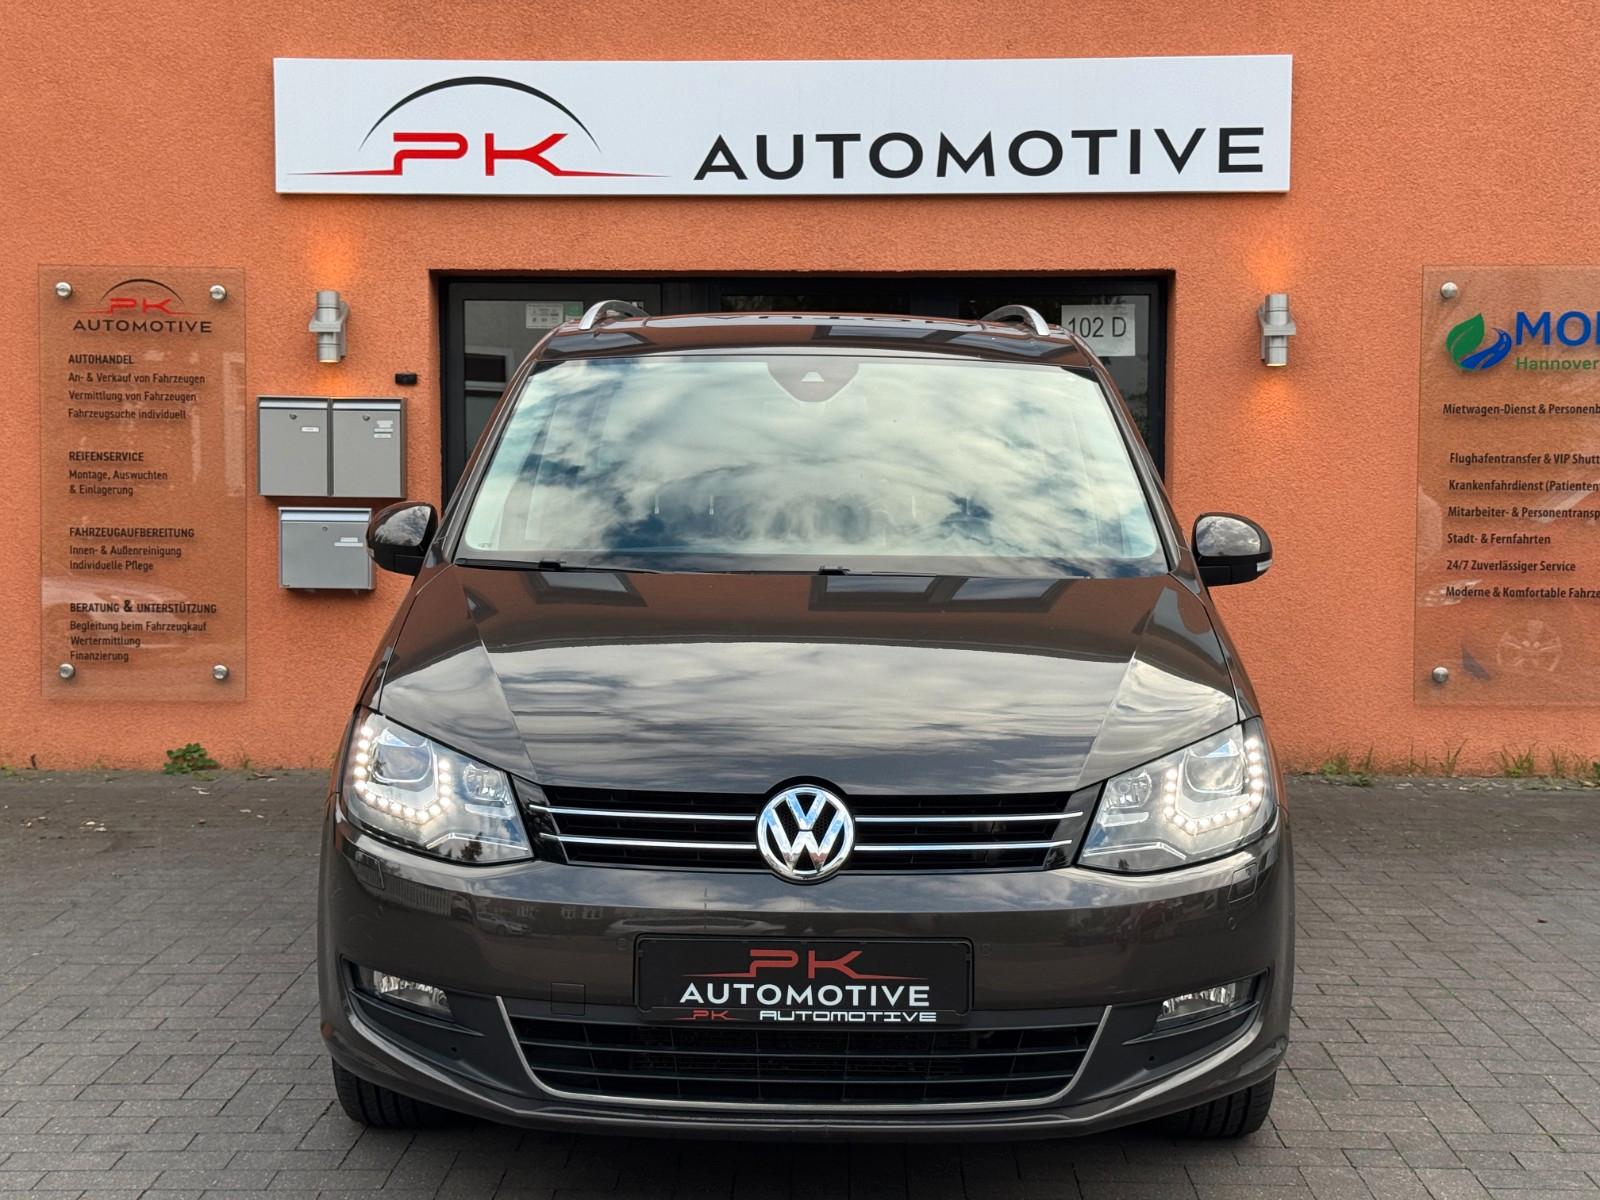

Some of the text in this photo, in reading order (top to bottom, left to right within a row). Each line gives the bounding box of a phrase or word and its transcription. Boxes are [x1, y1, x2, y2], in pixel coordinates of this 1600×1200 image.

[393, 126, 1263, 181] PK AUTOMOTIVE
[110, 297, 174, 315] PK
[73, 319, 213, 334] AUTOMOTIVE
[1068, 316, 1126, 338] 102 D
[68, 354, 134, 365] AUTOHANDEL
[1516, 357, 1599, 370] Hannover
[68, 373, 206, 386] An- & Verkauf von Fahrzeugen
[69, 391, 122, 403] Vermittlung
[144, 392, 196, 403] Fahrzeugen
[68, 408, 186, 420] Fahrzeugsuche individuell
[1443, 404, 1536, 416] Mietwagen-Dienst
[1538, 404, 1546, 414] &
[69, 452, 144, 462] REIFENSERVICE
[1450, 453, 1540, 466] Flughafentransfer
[1544, 454, 1551, 464] &
[1554, 454, 1570, 464] VIP
[69, 471, 168, 482] Montage, Auswuchten
[70, 485, 134, 496] & Einlagerung
[1449, 480, 1543, 491] Krankenfahrdienst
[1448, 506, 1509, 518] Mitarbeiter-
[1512, 507, 1519, 518] &
[70, 527, 195, 538] FAHRZEUGAUFBEREITUNG
[1448, 533, 1551, 544] Stadt- & Fernfahrten
[70, 546, 182, 558] Innen- & Außenreinigung
[70, 560, 154, 572] Individuelle Pflege
[1446, 560, 1576, 573] 24/7 Zuverlässiger Service
[1446, 586, 1490, 597] Moderne
[1492, 586, 1500, 597] &
[1502, 586, 1566, 598] Komfortable
[70, 600, 216, 614] BERATUNG & UNTERSTÜTZUNG
[70, 620, 207, 632] Begleitung beim Fahrzeugkauf
[70, 636, 141, 647] Wertermittlung
[70, 651, 129, 662] Finanzierung
[761, 788, 849, 876] VW
[750, 949, 863, 979] PK
[679, 982, 931, 1008] AUTOMOTIVE
[692, 1009, 937, 1023] PK AUTOMOTIVE
